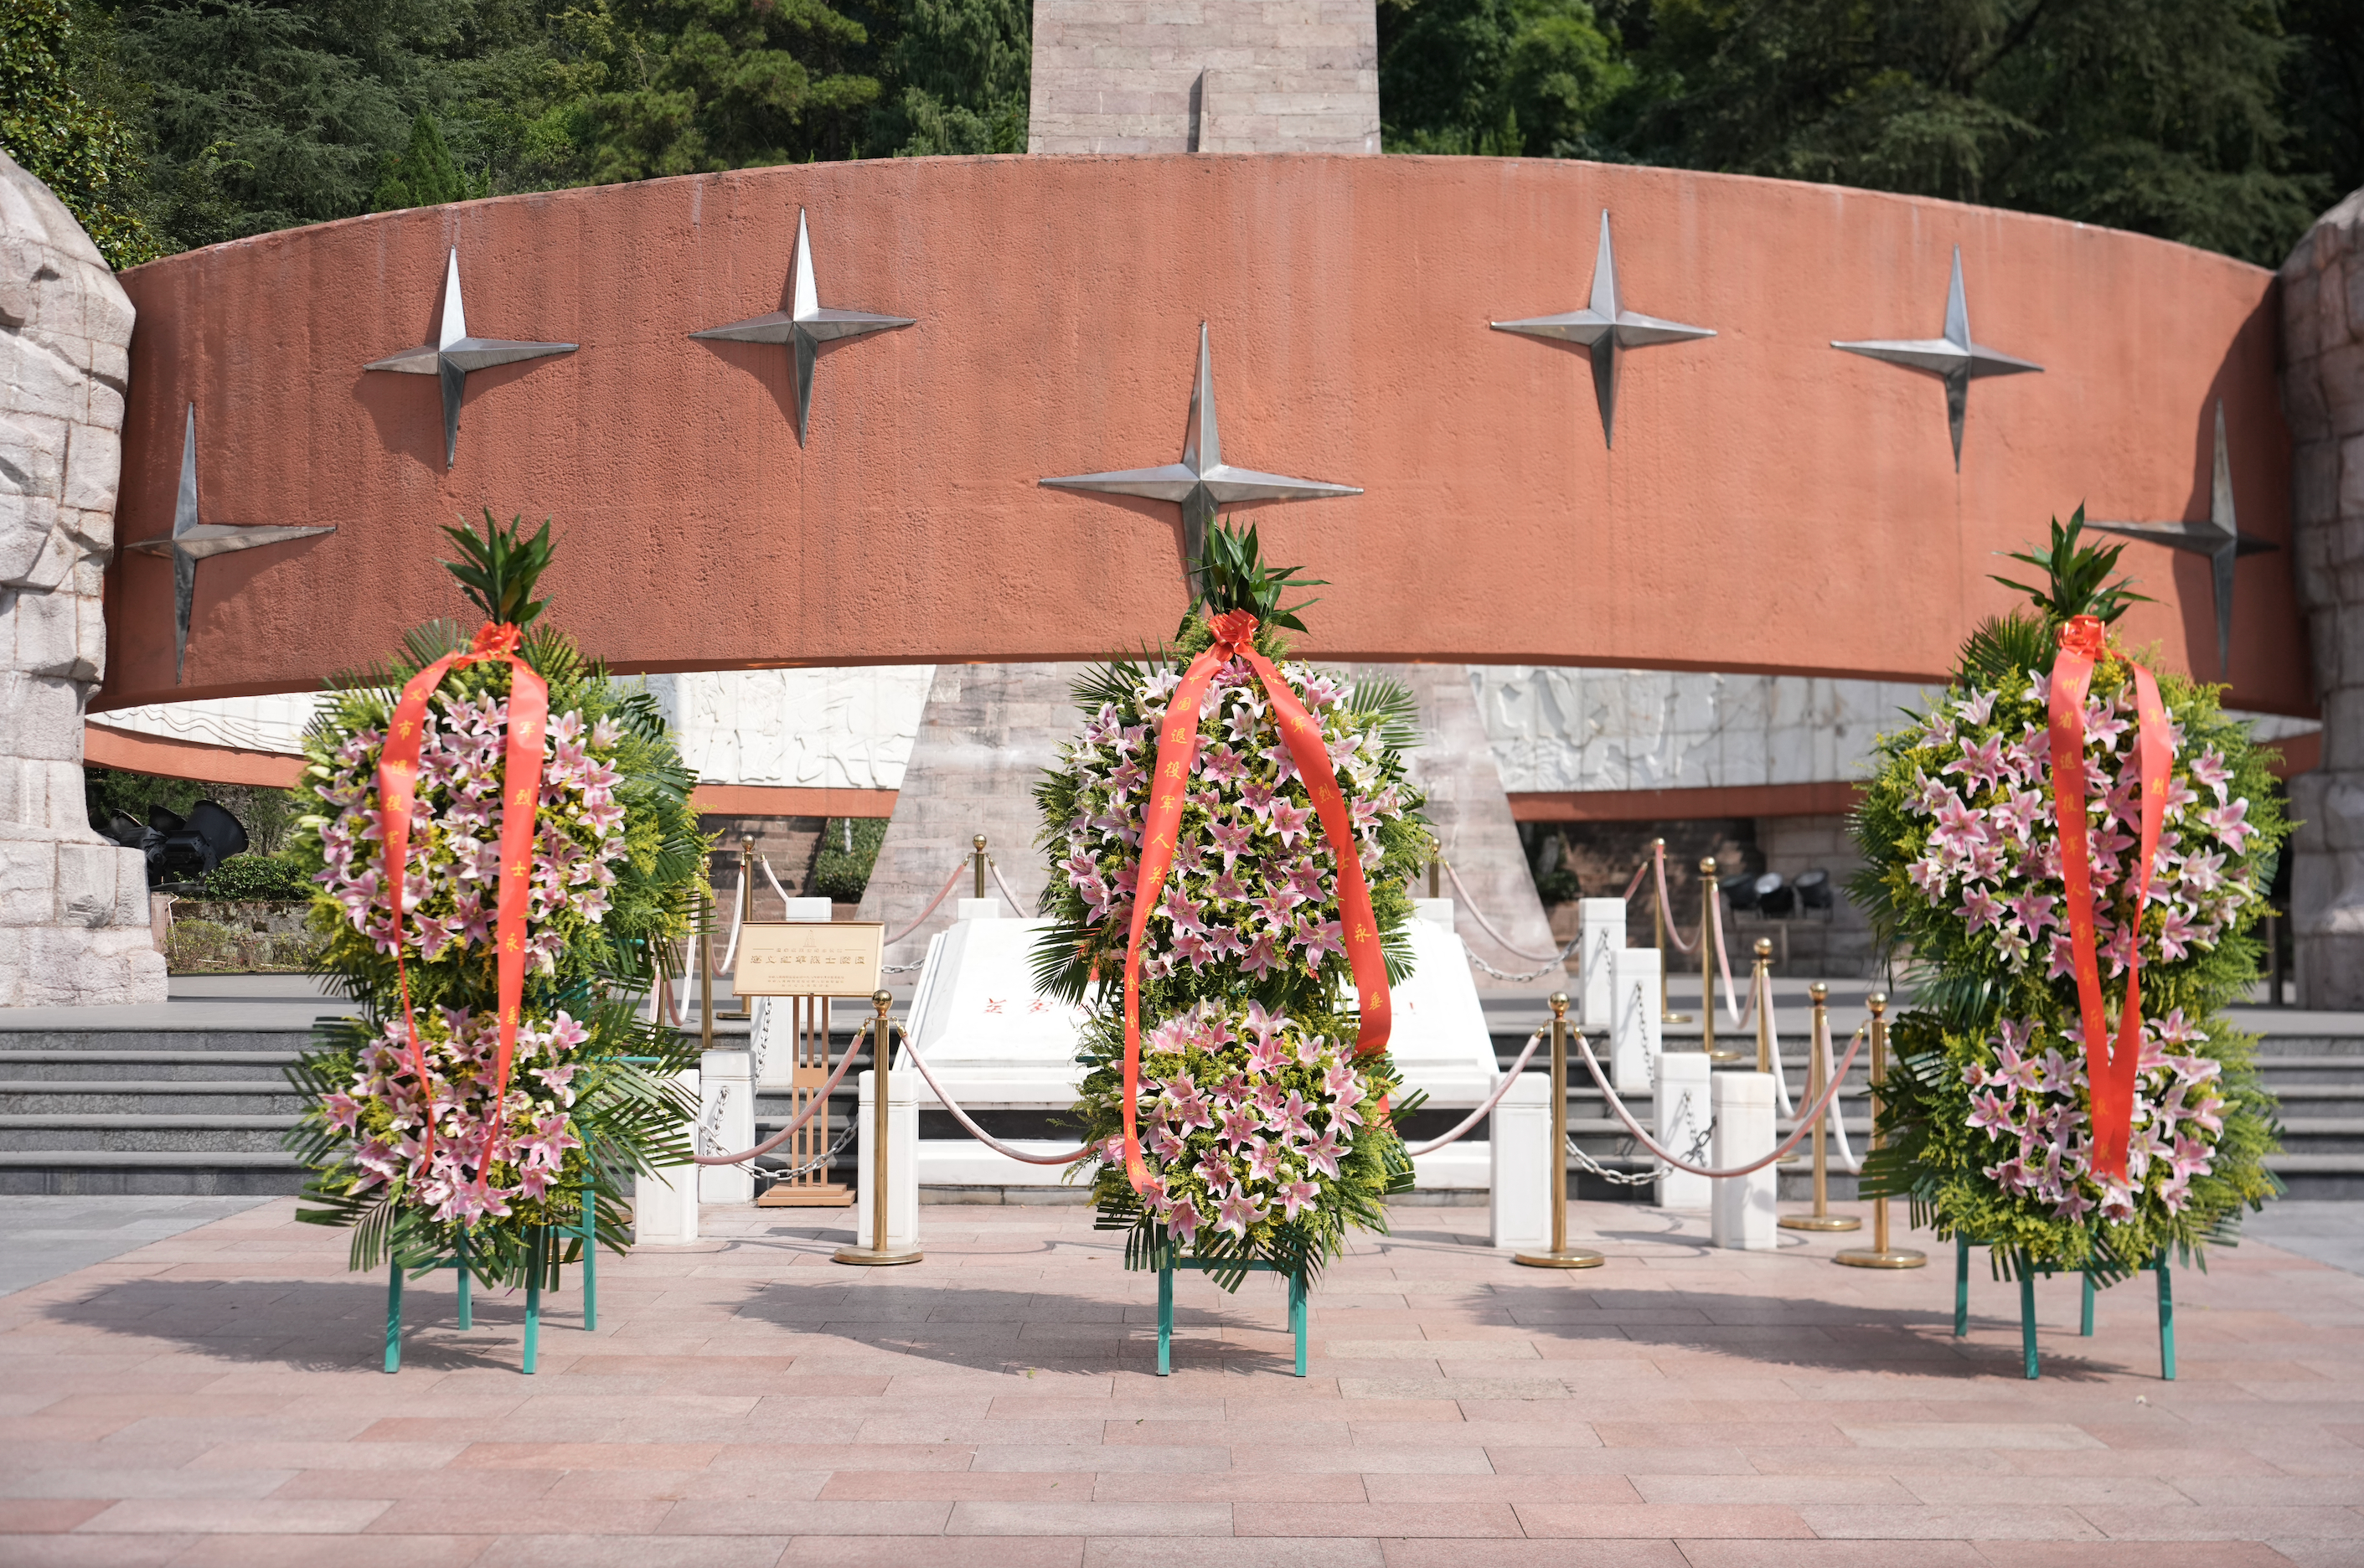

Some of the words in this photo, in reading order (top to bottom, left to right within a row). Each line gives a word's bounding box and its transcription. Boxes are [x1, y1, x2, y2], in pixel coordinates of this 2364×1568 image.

[1128, 674, 1203, 1029] 中国退役军人关爱金会
